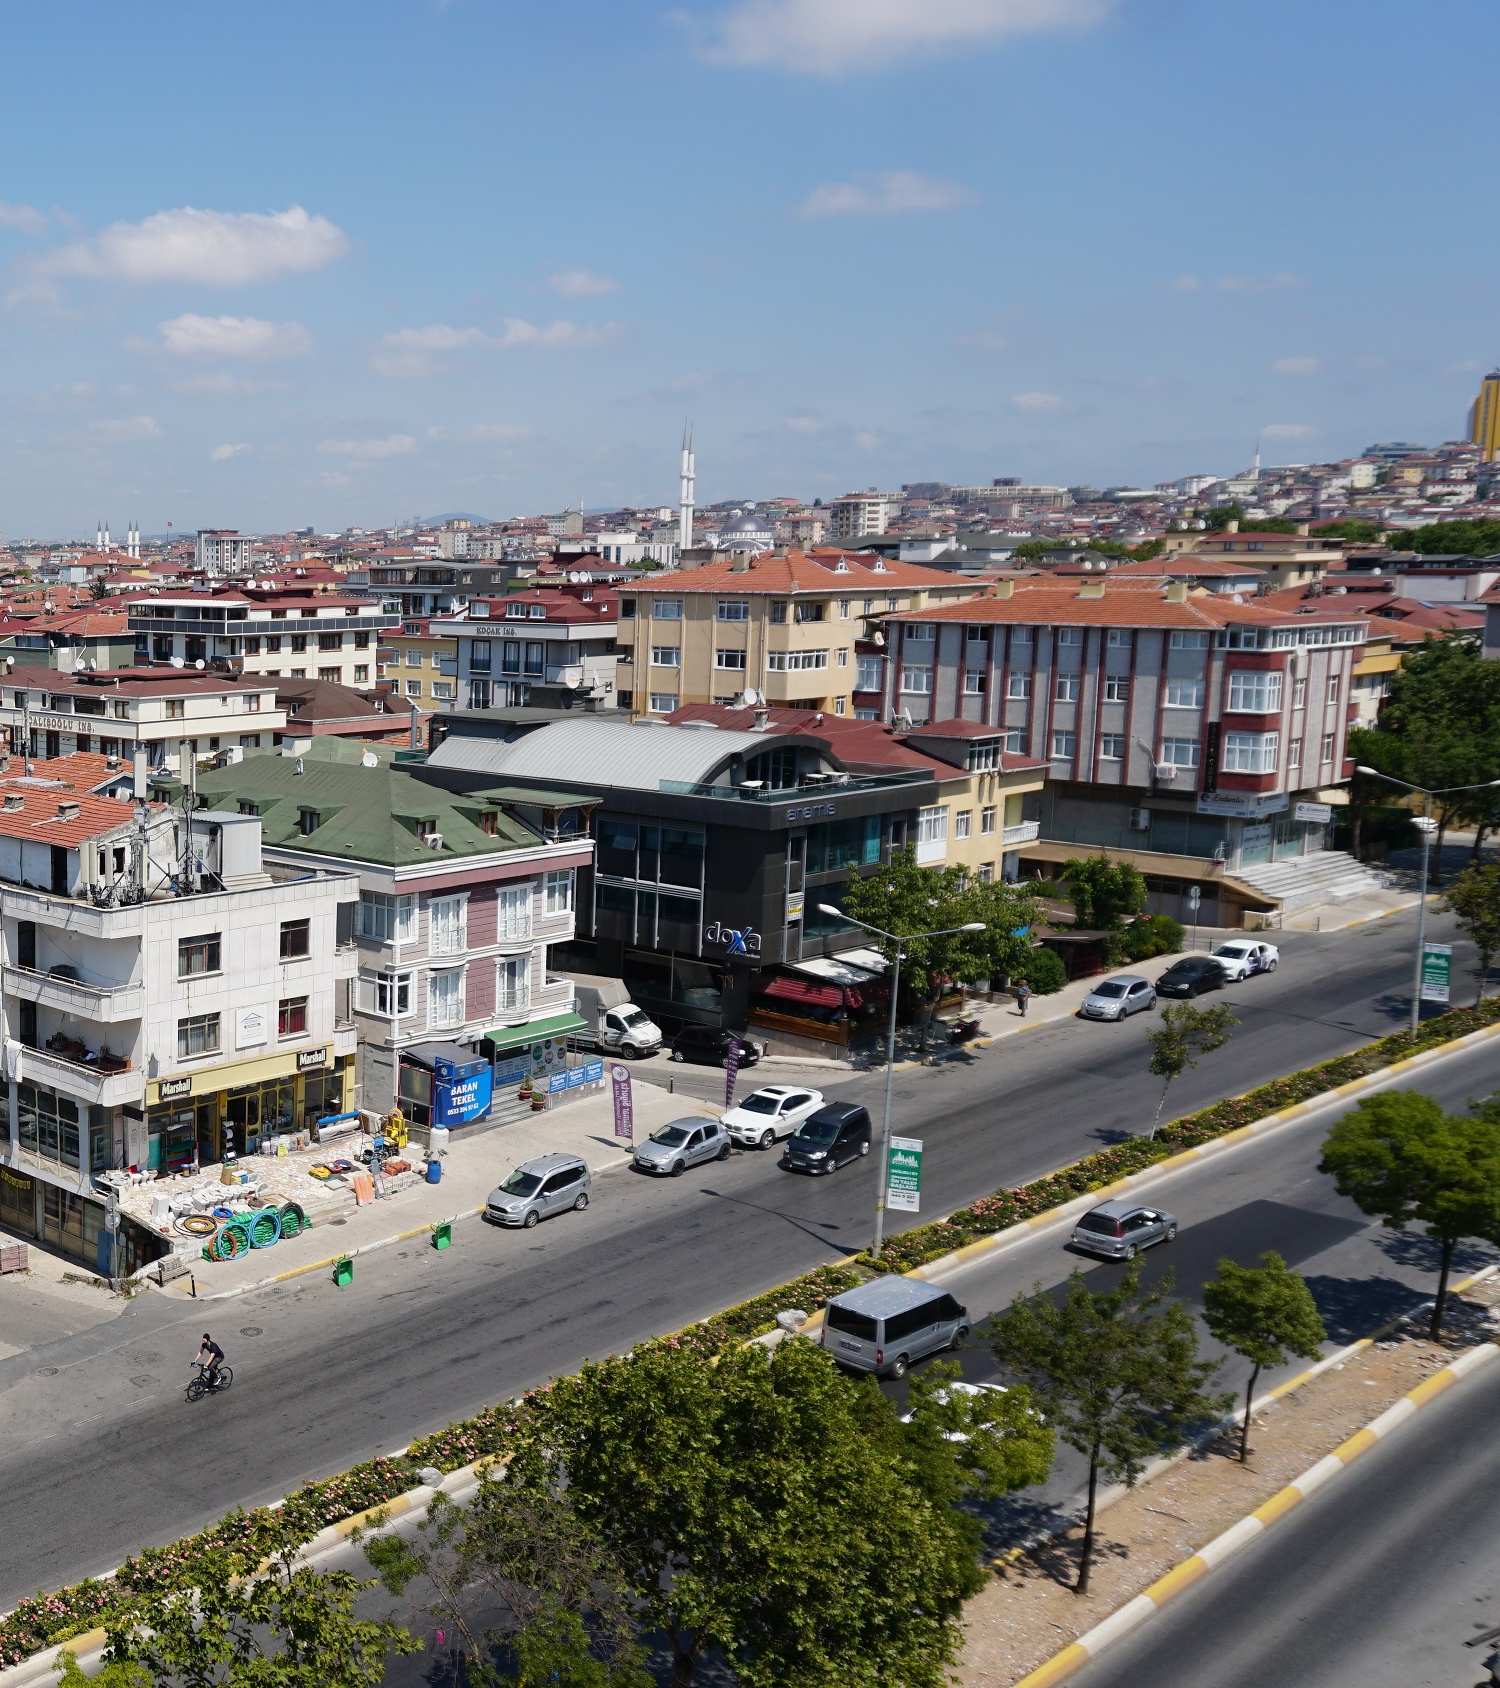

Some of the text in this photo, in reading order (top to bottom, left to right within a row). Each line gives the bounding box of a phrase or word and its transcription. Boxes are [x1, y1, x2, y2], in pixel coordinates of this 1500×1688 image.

[476, 626, 501, 636] KOÇAK
[787, 803, 836, 822] aramis
[300, 1048, 326, 1066] Marshall
[161, 1078, 191, 1096] Marshall
[451, 1081, 479, 1096] BARAN
[452, 1093, 476, 1106] TEKEL
